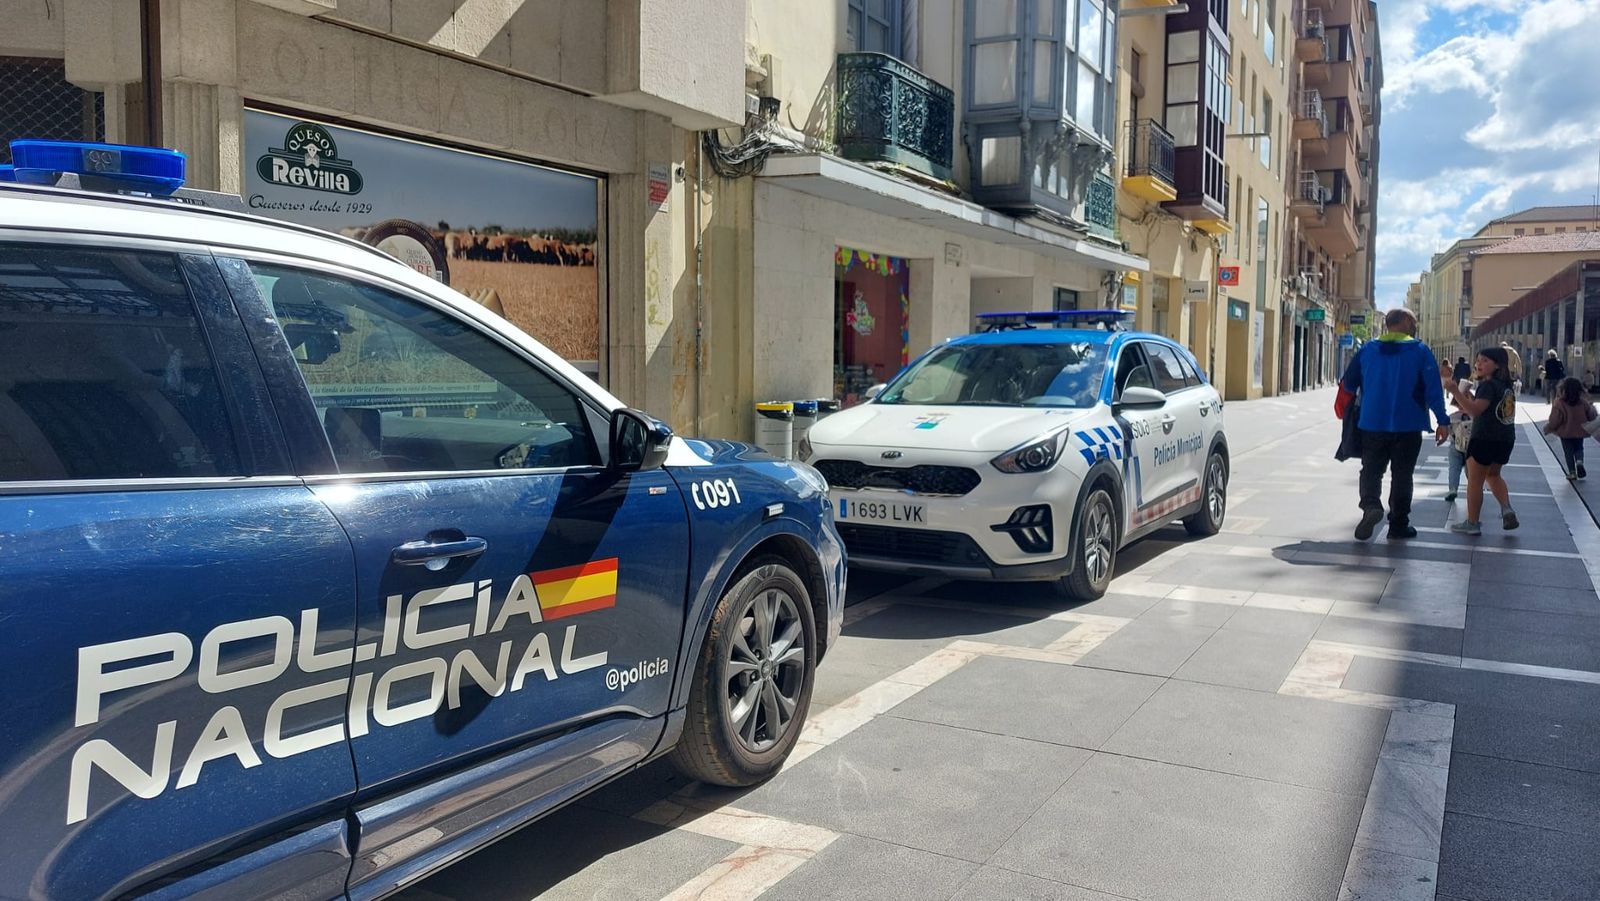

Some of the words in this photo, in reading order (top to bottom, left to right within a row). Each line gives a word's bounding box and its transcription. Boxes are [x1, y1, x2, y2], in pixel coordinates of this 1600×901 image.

[288, 129, 334, 157] QUESOS
[248, 193, 305, 211] Queseros
[309, 200, 341, 213] desde
[346, 202, 373, 214] 1929
[1177, 430, 1204, 456] Municipal
[702, 478, 741, 509] 091
[851, 502, 887, 519] 1693
[893, 505, 923, 522] LVK
[605, 657, 669, 692] @policia
[66, 624, 608, 825] NACIONAL
